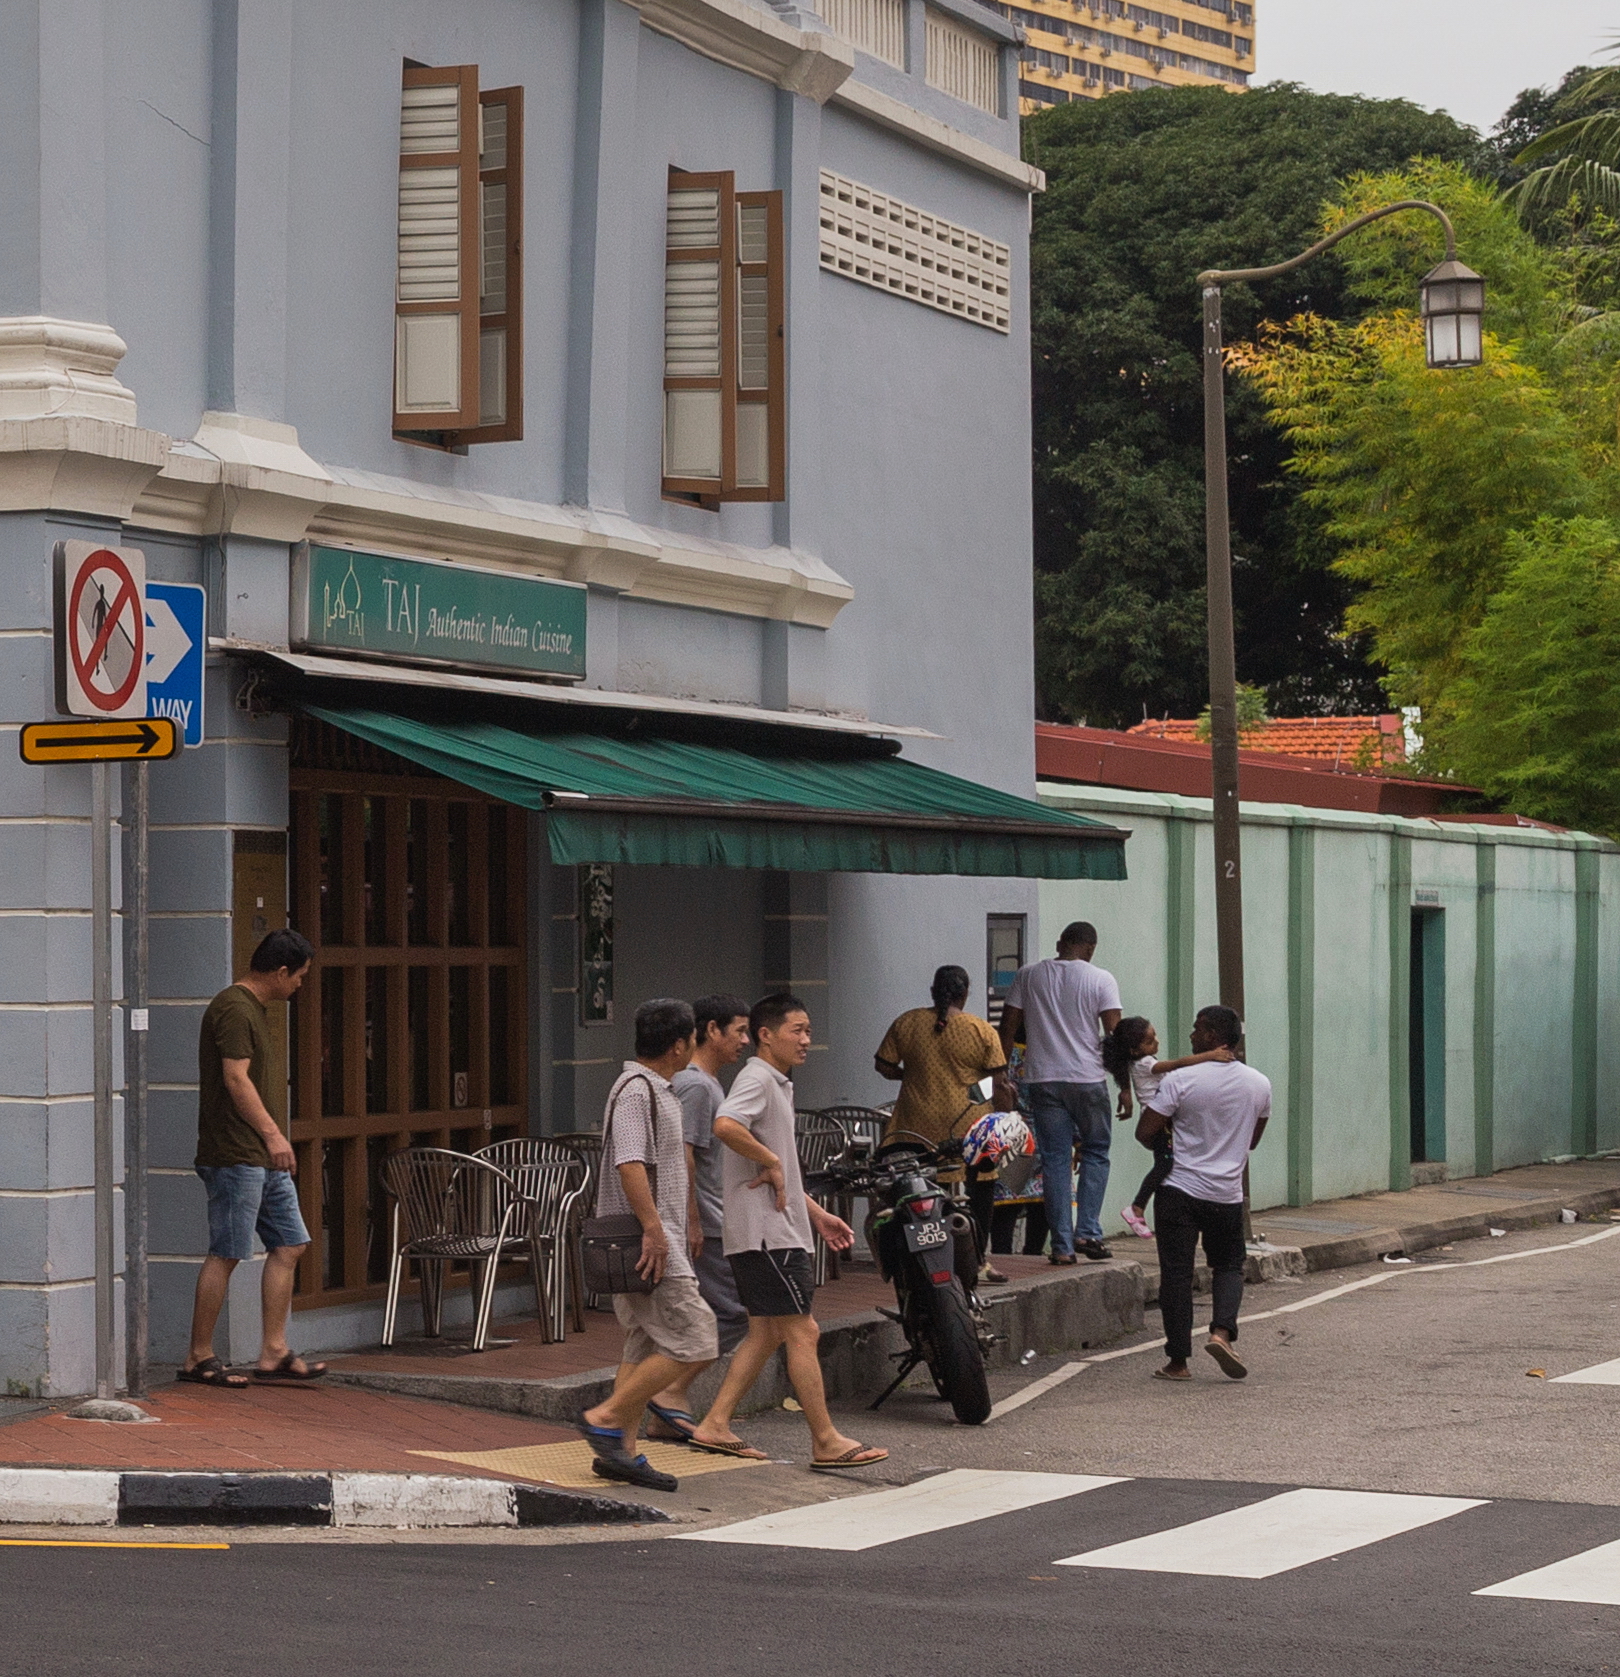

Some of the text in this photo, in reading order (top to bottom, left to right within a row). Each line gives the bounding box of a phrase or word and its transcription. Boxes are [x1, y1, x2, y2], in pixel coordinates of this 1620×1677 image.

[346, 609, 365, 645] TAJ
[382, 578, 573, 655] TAJ Authentic Indian Cuisine
[151, 696, 193, 730] WAY
[1224, 860, 1236, 878] 2
[917, 1231, 948, 1246] 9013
[918, 1222, 941, 1235] JPJ
